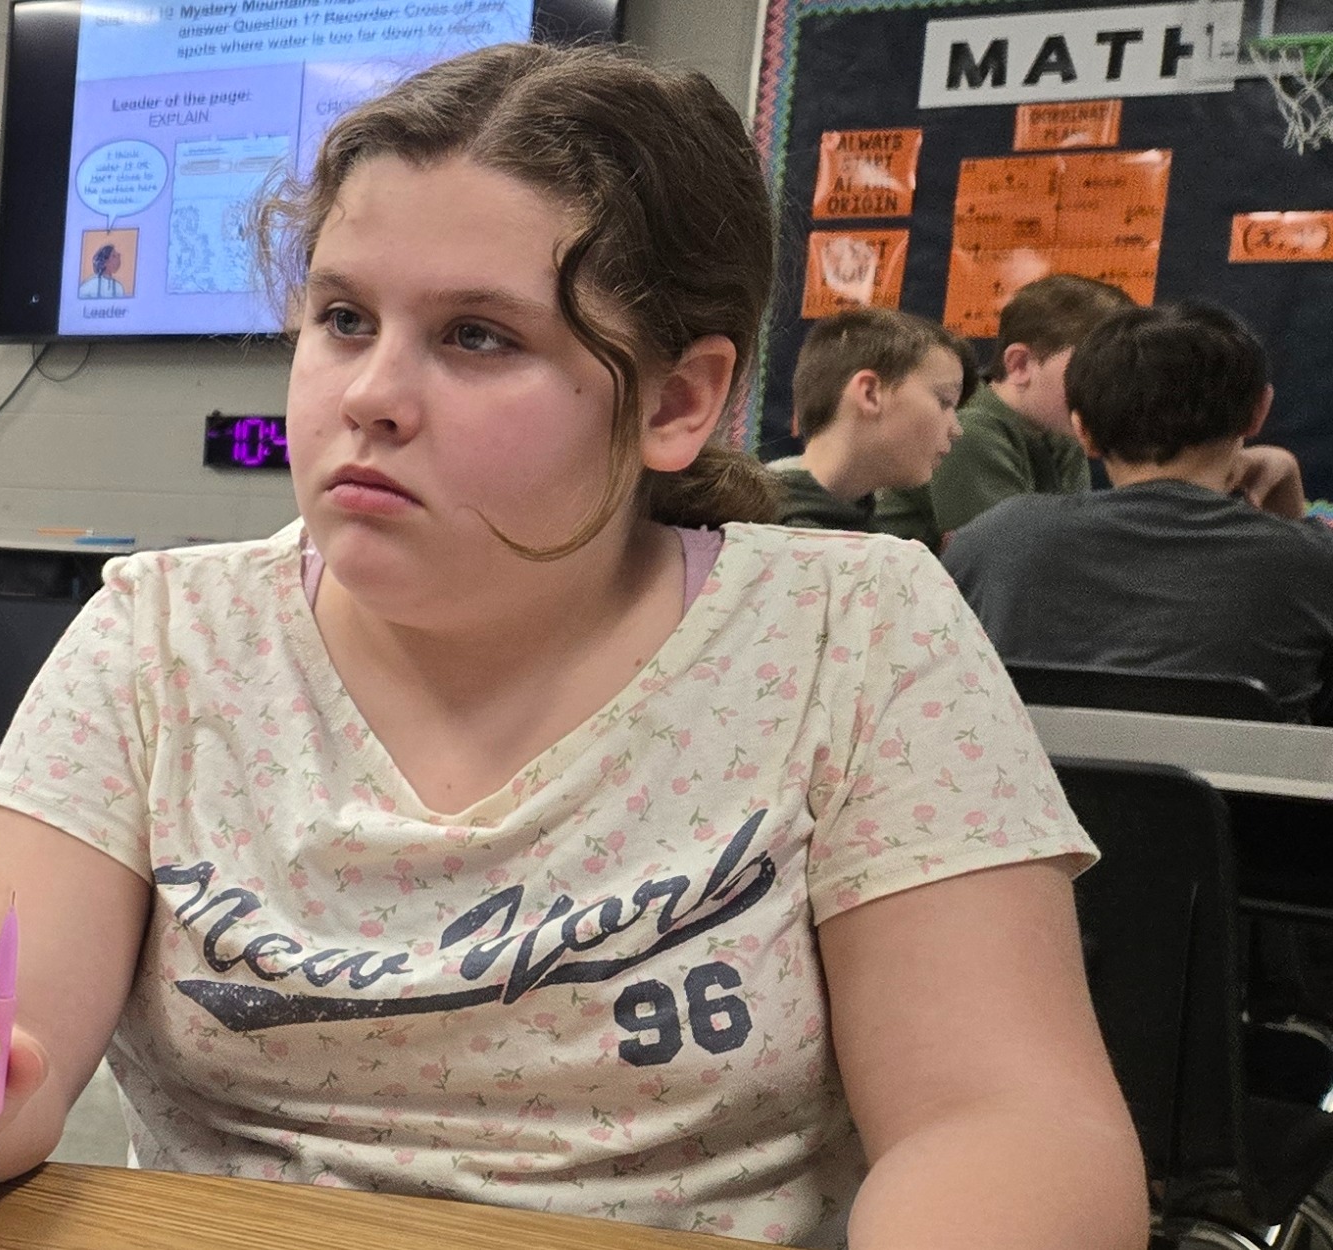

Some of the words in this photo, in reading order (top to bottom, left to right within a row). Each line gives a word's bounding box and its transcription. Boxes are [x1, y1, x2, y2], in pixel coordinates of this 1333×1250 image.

[179, 25, 228, 39] answer
[234, 17, 298, 33] Question
[404, 3, 448, 18] Cross
[453, 1, 472, 15] off
[180, 1, 237, 21] Mystery
[177, 43, 217, 58] spots
[221, 39, 263, 54] where
[268, 35, 306, 49] water
[312, 32, 324, 45] is
[329, 31, 353, 44] too
[358, 27, 376, 41] far
[381, 25, 423, 40] down
[428, 22, 443, 36] to
[112, 96, 159, 111] Leader
[165, 92, 179, 107] of
[183, 91, 206, 106] the
[149, 108, 211, 128] EXPLAIN
[837, 132, 902, 151] ALWAYS
[826, 194, 899, 214] ORIGIN
[82, 305, 128, 319] Leader
[155, 861, 415, 989] New
[440, 808, 775, 1004] York
[613, 961, 752, 1067] 96
